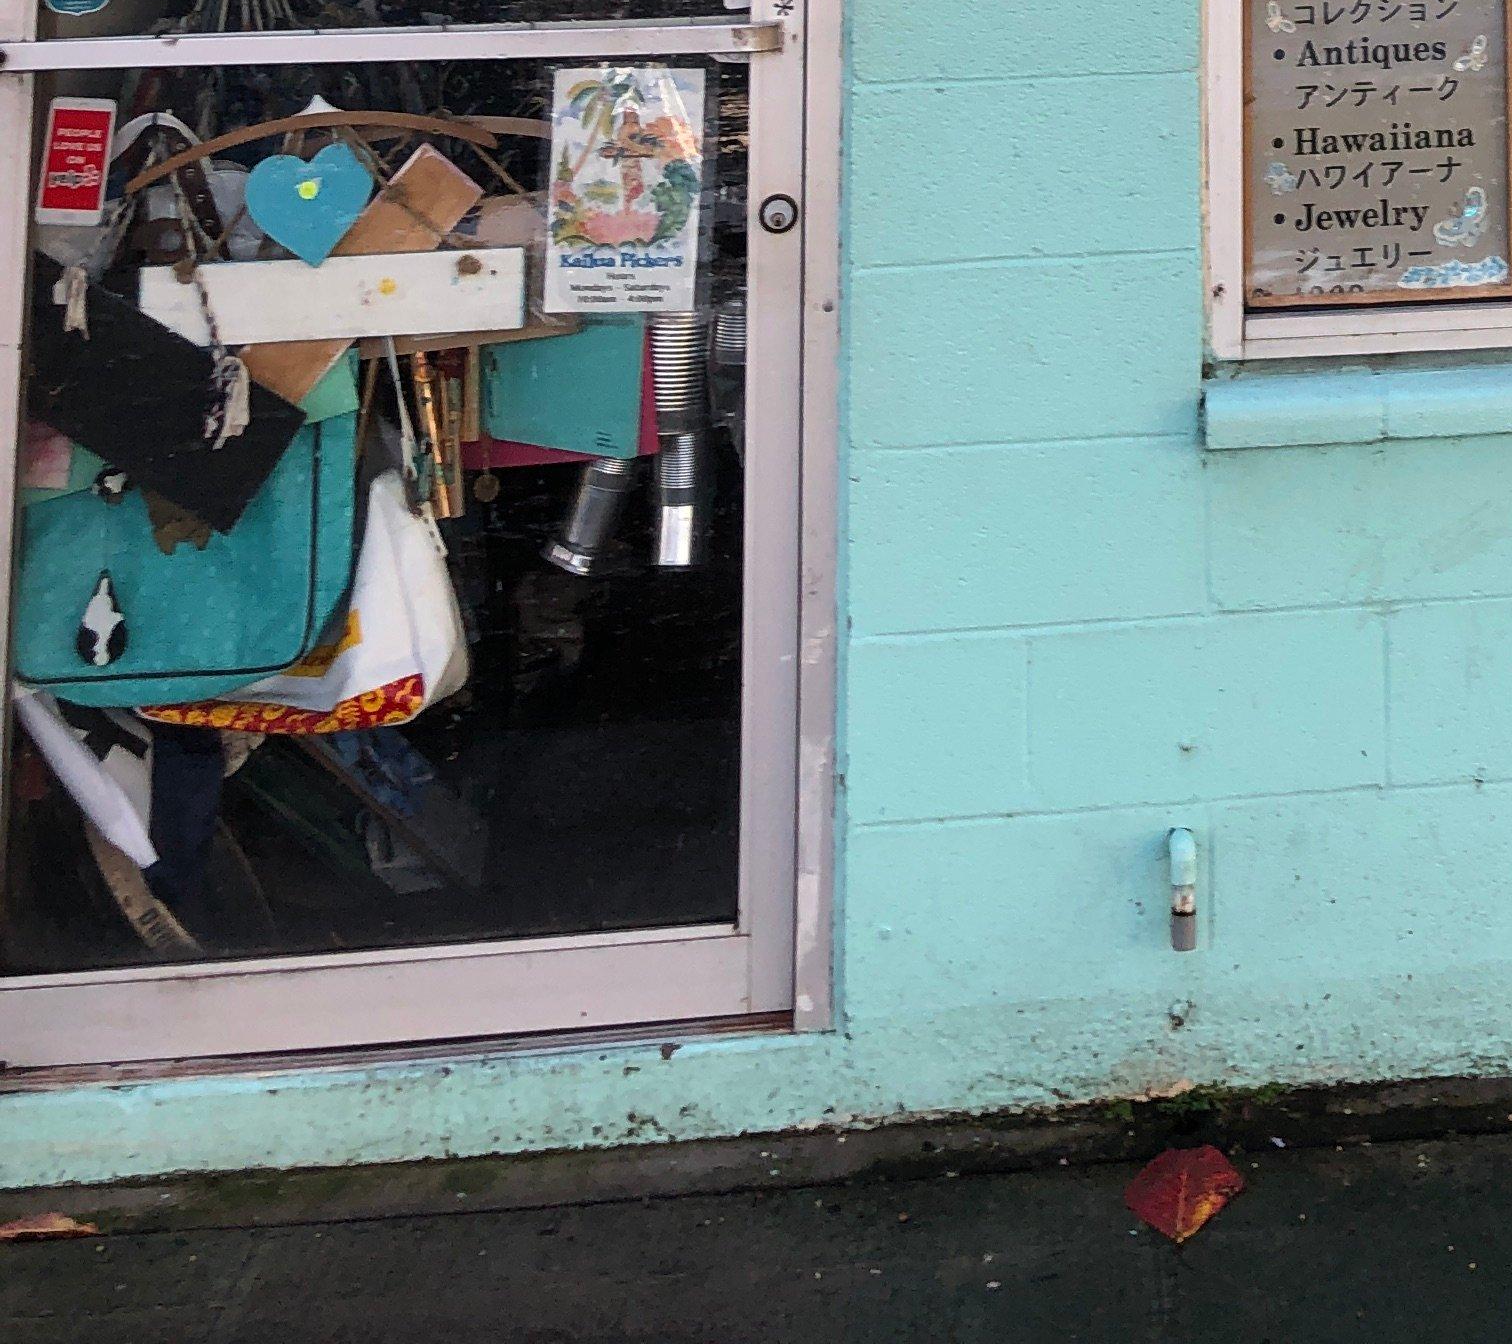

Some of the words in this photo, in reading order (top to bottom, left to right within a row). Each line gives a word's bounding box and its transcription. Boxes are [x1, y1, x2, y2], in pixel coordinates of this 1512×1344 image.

[1296, 36, 1447, 69] Antiques
[1296, 77, 1460, 110] アンティーク
[1293, 122, 1476, 156] Hawaiiana
[1296, 156, 1462, 189] ハワイアーナ
[1295, 199, 1430, 232] Jewelry
[1295, 243, 1433, 273] ジュエリー
